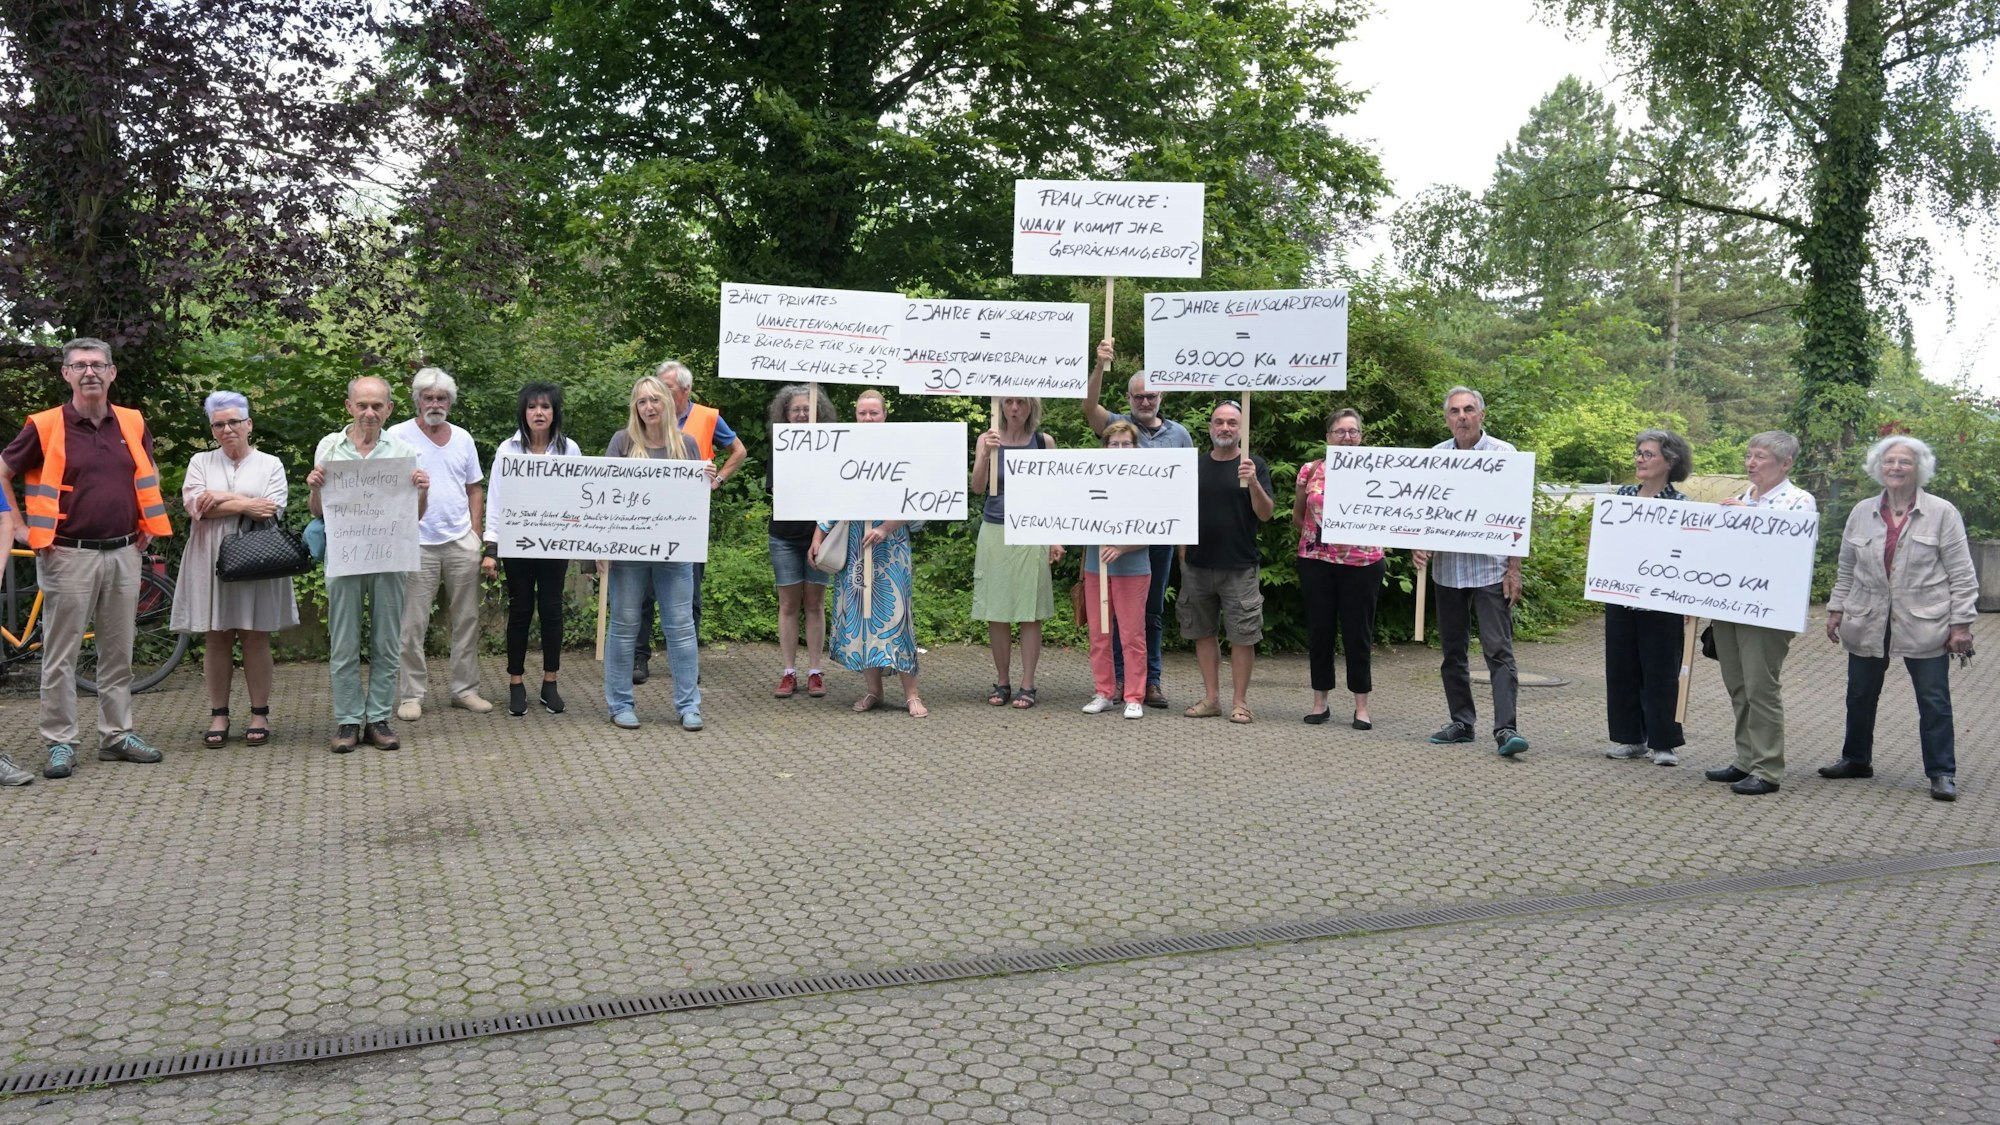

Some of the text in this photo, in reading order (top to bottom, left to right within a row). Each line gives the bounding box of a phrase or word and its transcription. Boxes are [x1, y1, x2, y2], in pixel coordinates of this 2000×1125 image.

[1038, 189, 1083, 208] FRAU
[1019, 216, 1066, 232] WANN
[1074, 221, 1124, 235] KOMMT
[1050, 240, 1200, 266] GESPRÄCHSANGEBOT?
[728, 289, 838, 307] ZÄHLT PRIVATES
[1150, 297, 1168, 322] 2
[1172, 298, 1220, 319] JAHRE
[1259, 294, 1346, 312] SOLARSTROM
[756, 312, 894, 336] UMWELTENGAGEMENT
[905, 304, 1074, 322] 2 JAHRE KEIN SOLARSTROM
[724, 331, 751, 344] DER
[754, 333, 815, 349] BÜRGER
[819, 339, 844, 351] FÜR
[845, 342, 864, 354] SIE
[750, 355, 887, 380] FRAU SCHULZE??
[902, 348, 1083, 367] JAHRESSTROMVERBRAUCH VON
[1174, 348, 1343, 368] 69.000 KG NICHT
[924, 368, 1087, 390] 30 EINFAMILIENHÄUSERN
[1149, 370, 1221, 385] ERSPARTE
[775, 428, 850, 452] STADT
[502, 456, 704, 482] DACHFLÄCHENNUTZUNGSVERTRAG
[840, 459, 911, 482] OHNE
[1006, 458, 1182, 479] VERTRAUENSVERLUST
[1331, 451, 1507, 474] BÜRGERSOLARANLAGE
[333, 470, 399, 489] Mietvertrag
[1365, 480, 1455, 500] 2 JAHRE
[641, 491, 651, 506] 6
[901, 488, 965, 514] KOPF
[1009, 513, 1181, 536] VERWALTUNGSFRUST
[1323, 518, 1367, 530] REAKTION
[1368, 523, 1386, 531] DER
[1338, 503, 1527, 530] VERTRAGSBRUCH OHNE
[1600, 500, 1816, 539] 2 JAHRE KEIN SOLARSTROM
[1638, 559, 1769, 592] 600.000 KM
[1588, 577, 1776, 619] VERPASSTE E-AUTO-MOBILITÄT
